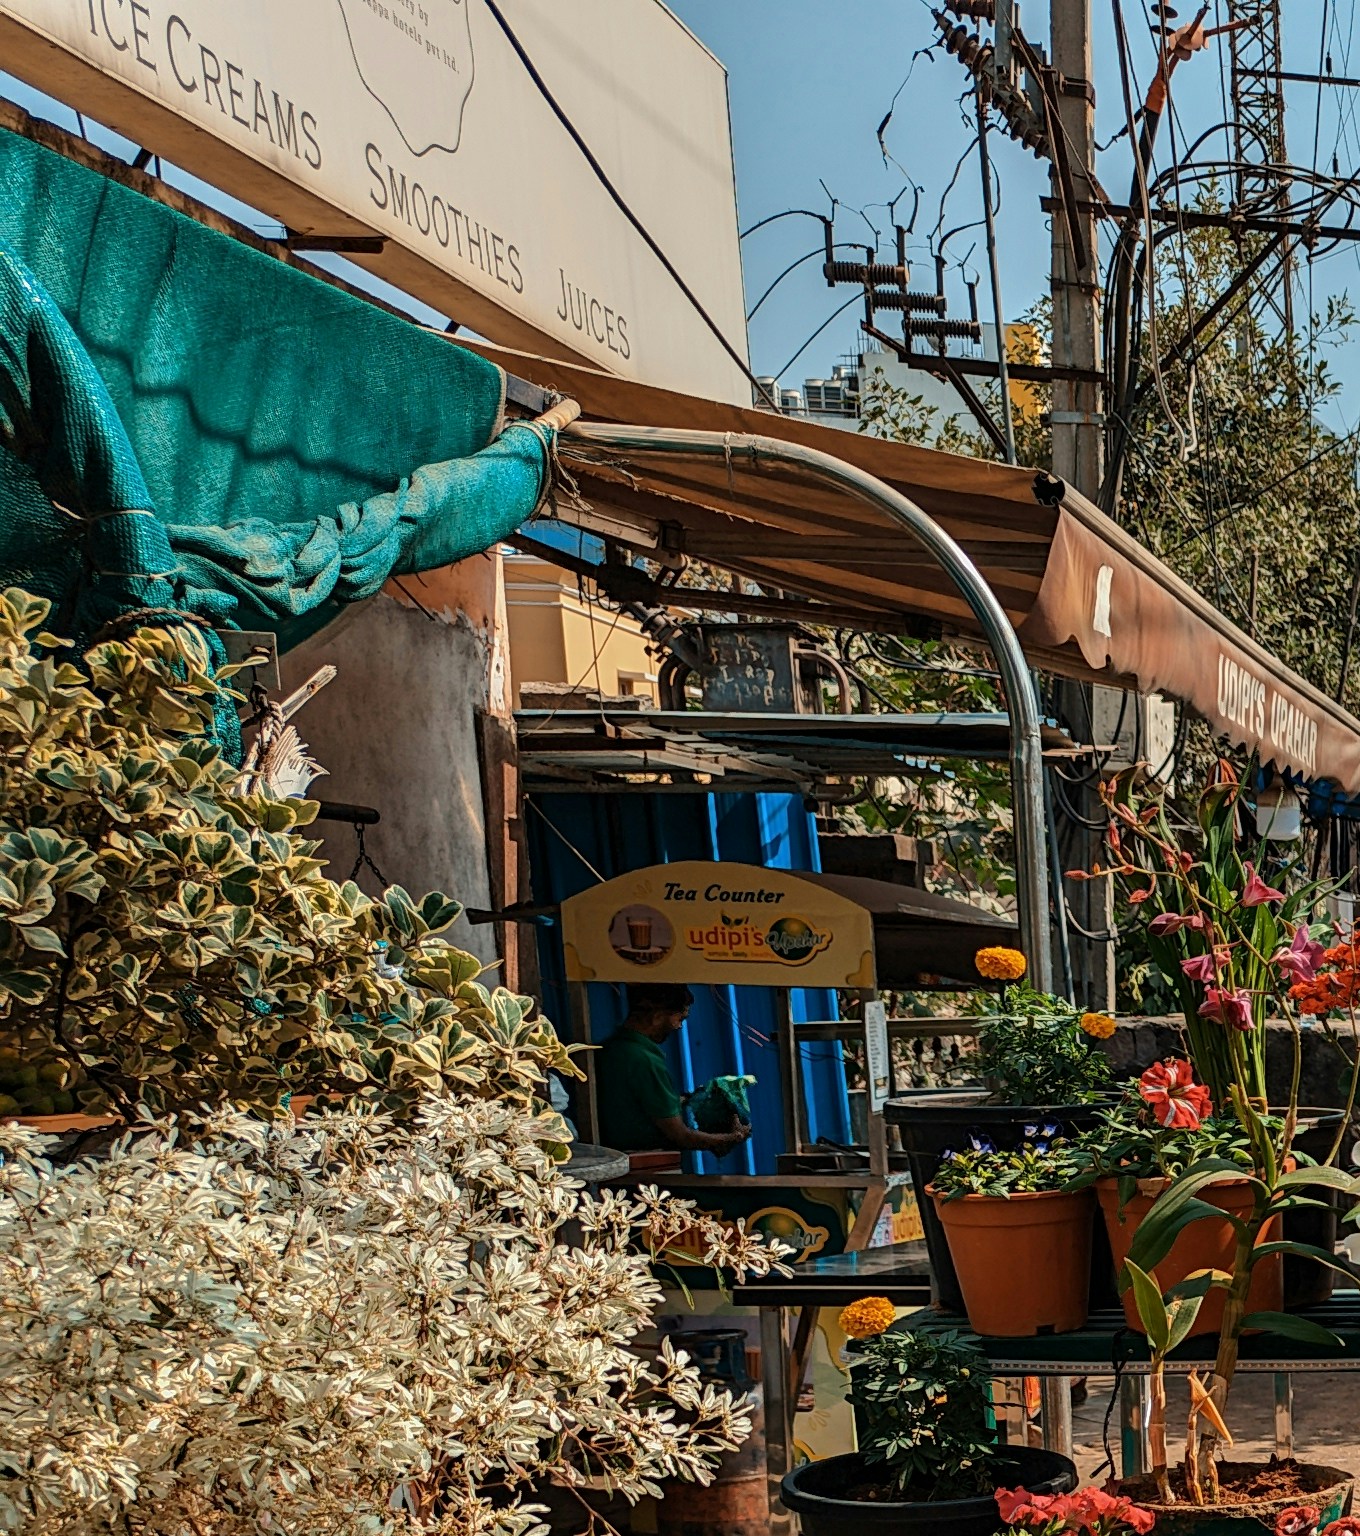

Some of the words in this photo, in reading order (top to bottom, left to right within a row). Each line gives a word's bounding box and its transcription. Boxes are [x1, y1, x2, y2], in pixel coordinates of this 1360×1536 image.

[418, 4, 428, 27] by
[392, 10, 423, 46] hotels
[425, 39, 441, 60] pvt
[443, 49, 460, 75] ltd.
[88, 0, 157, 75] ICE
[167, 14, 322, 170] CREAMS
[365, 142, 524, 294] SMOOTHIES
[556, 268, 631, 360] JUICES
[1217, 652, 1267, 741] UDIPI'S
[1269, 690, 1319, 773] UPAHAR
[663, 882, 697, 901] Tea
[703, 883, 785, 904] Counter
[689, 926, 764, 950] udipi's
